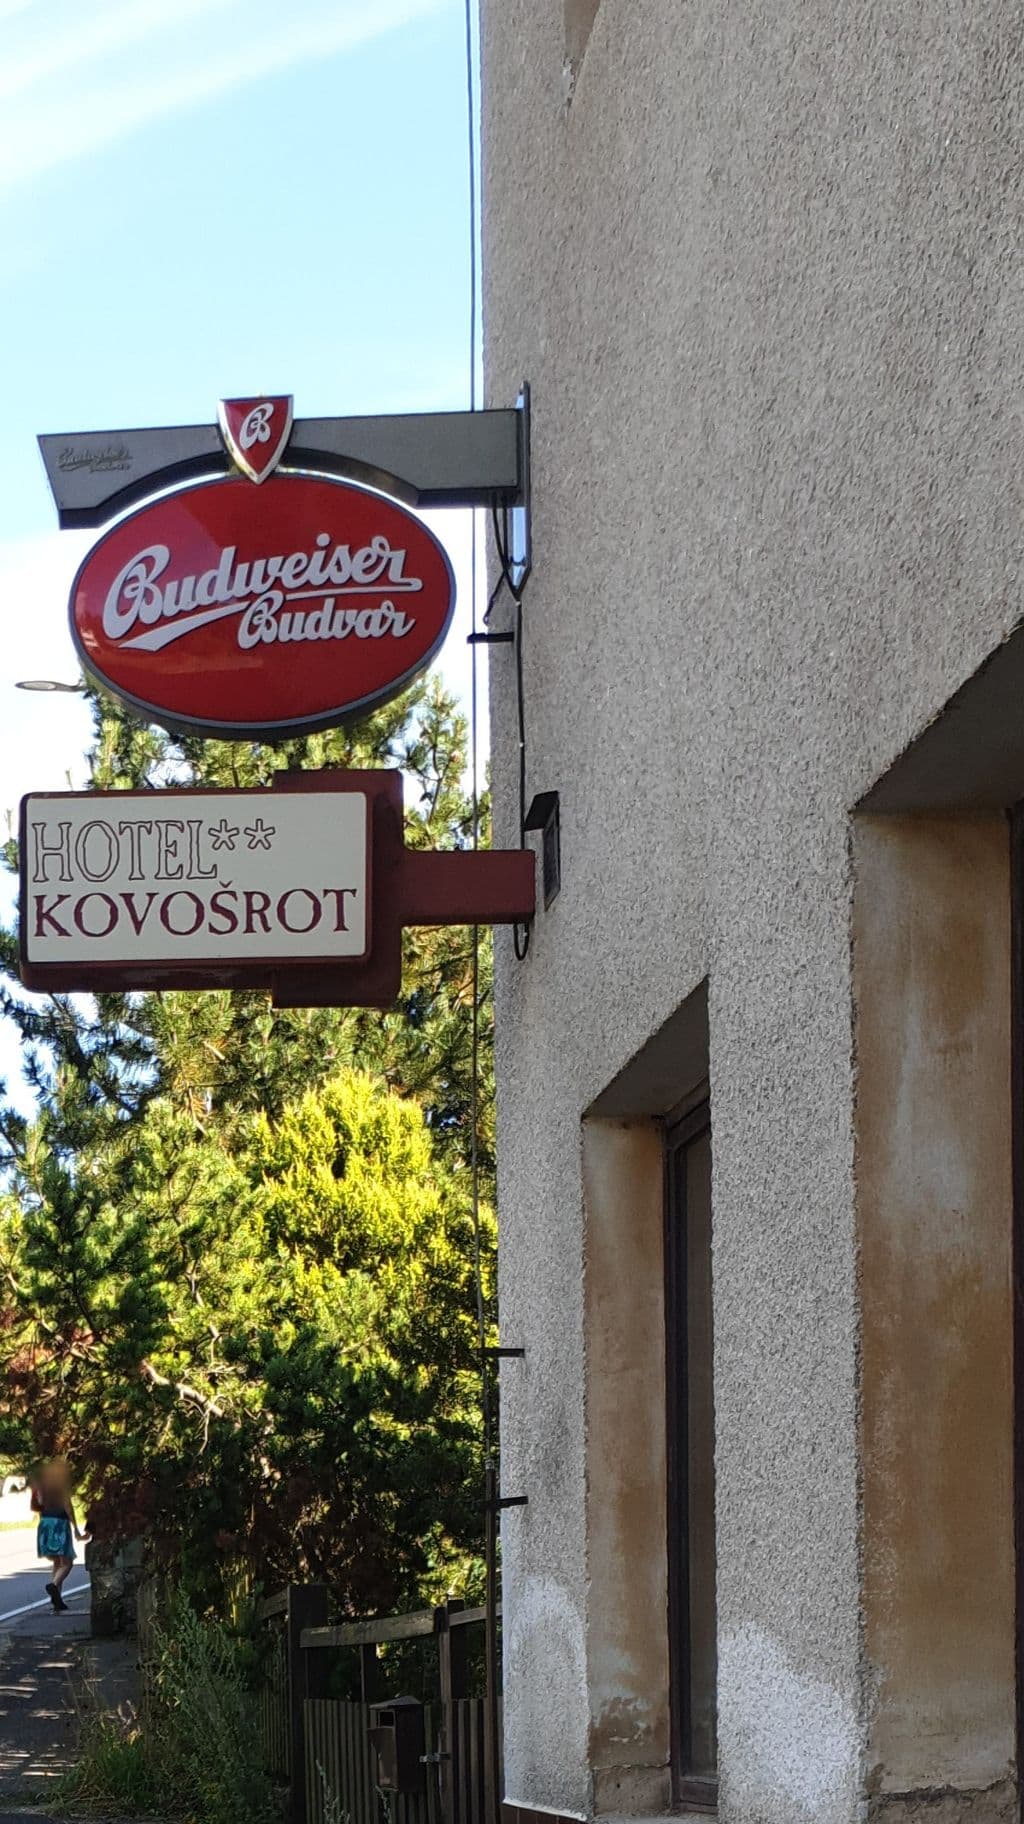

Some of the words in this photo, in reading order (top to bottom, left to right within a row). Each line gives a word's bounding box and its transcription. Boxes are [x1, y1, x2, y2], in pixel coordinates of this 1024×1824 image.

[240, 402, 274, 450] B
[103, 533, 423, 641] Budweiser
[237, 590, 415, 650] Budvar
[33, 880, 357, 938] KOVOŠROT
